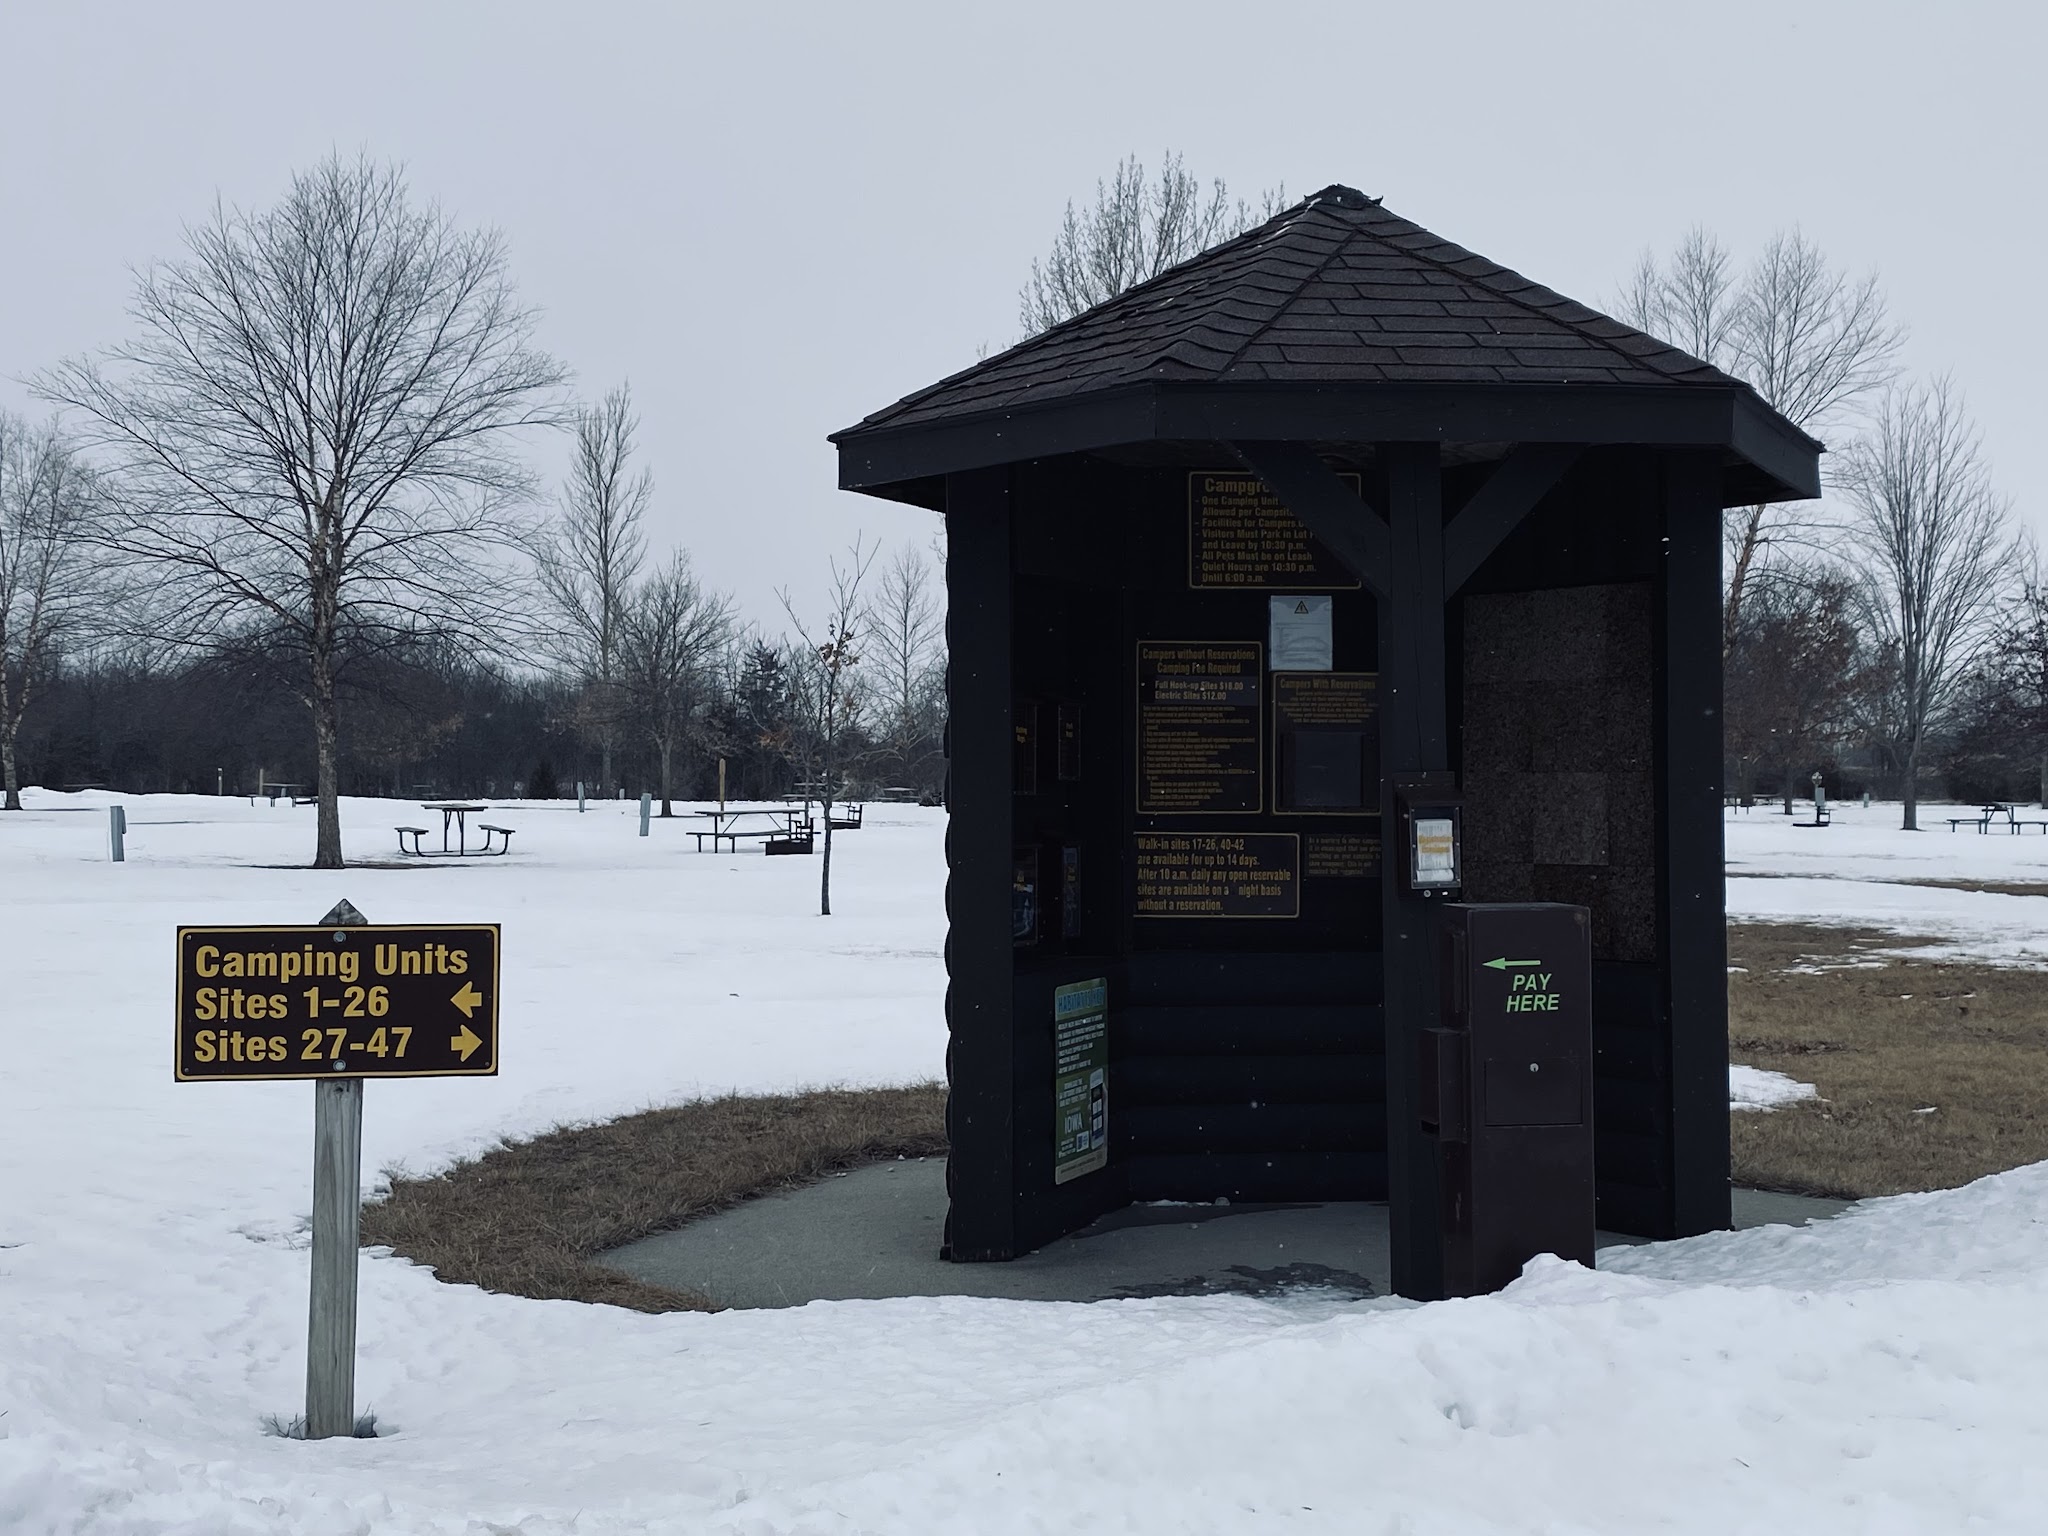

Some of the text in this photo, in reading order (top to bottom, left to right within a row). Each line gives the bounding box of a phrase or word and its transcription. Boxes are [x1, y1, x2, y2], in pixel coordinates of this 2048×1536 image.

[1202, 496, 1279, 507] One Camping Unit
[1202, 508, 1236, 516] Allowed
[1239, 509, 1252, 518] per
[1202, 518, 1242, 527] Facilities
[1244, 518, 1256, 527] for
[1259, 518, 1296, 529] Campers
[1202, 530, 1234, 538] Visitors
[1237, 530, 1258, 538] Must
[1261, 530, 1281, 538] Park
[1284, 530, 1292, 538] in
[1294, 530, 1307, 538] Lot
[1202, 540, 1306, 552] and Leave by 10:30 p.m.
[1202, 551, 1214, 560] All
[1216, 551, 1235, 560] Pets
[1238, 551, 1258, 560] Must
[1261, 551, 1272, 560] be
[1288, 551, 1312, 560] Leash
[1202, 562, 1225, 572] Quiet
[1228, 562, 1252, 571] Hours
[1272, 562, 1296, 571] 10:30
[1298, 564, 1317, 573] p.m.
[1202, 574, 1222, 582] Until
[1225, 574, 1244, 582] 6:00
[1138, 838, 1169, 850] Walk-in
[1171, 838, 1190, 850] sites
[1220, 838, 1244, 850] 40-42
[1138, 854, 1260, 868] are available for up to 14 days.
[1138, 869, 1291, 883] After 10 a.m. daily any open reservable
[1138, 884, 1282, 898] sites are available on a night basis
[1138, 899, 1224, 910] without a reservation.
[195, 943, 468, 984] Camping Units
[1512, 973, 1552, 992] PAY
[194, 986, 390, 1020] Sites 1-26
[1506, 993, 1560, 1013] HERE
[194, 1026, 413, 1062] Sites 27-47
[1064, 1112, 1083, 1134] IOWA
